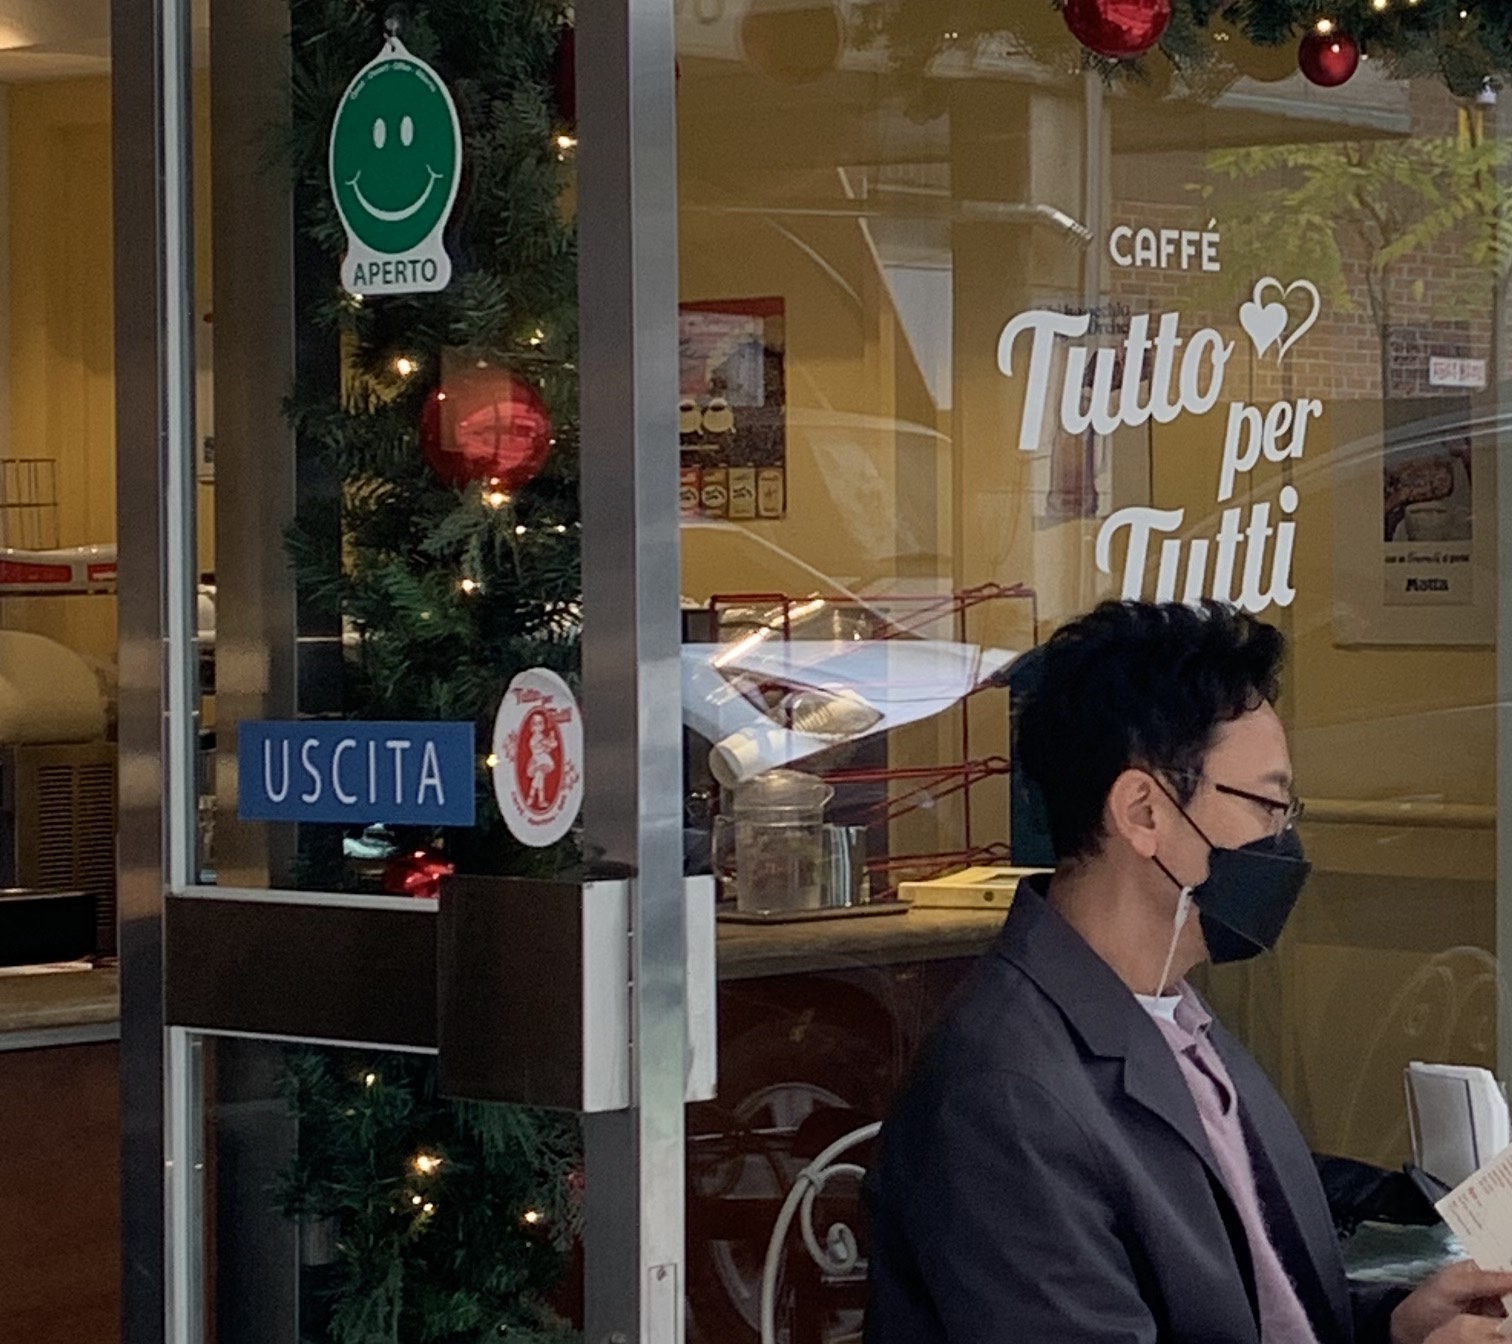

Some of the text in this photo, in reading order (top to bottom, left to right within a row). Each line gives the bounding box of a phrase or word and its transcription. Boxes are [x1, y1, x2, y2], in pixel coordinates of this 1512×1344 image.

[353, 258, 437, 286] APERTO
[1109, 219, 1221, 272] CAFFÉ
[997, 309, 1234, 451] Tutto
[1218, 397, 1322, 502] per
[1095, 485, 1297, 617] Tutti
[263, 738, 446, 805] USCITA
